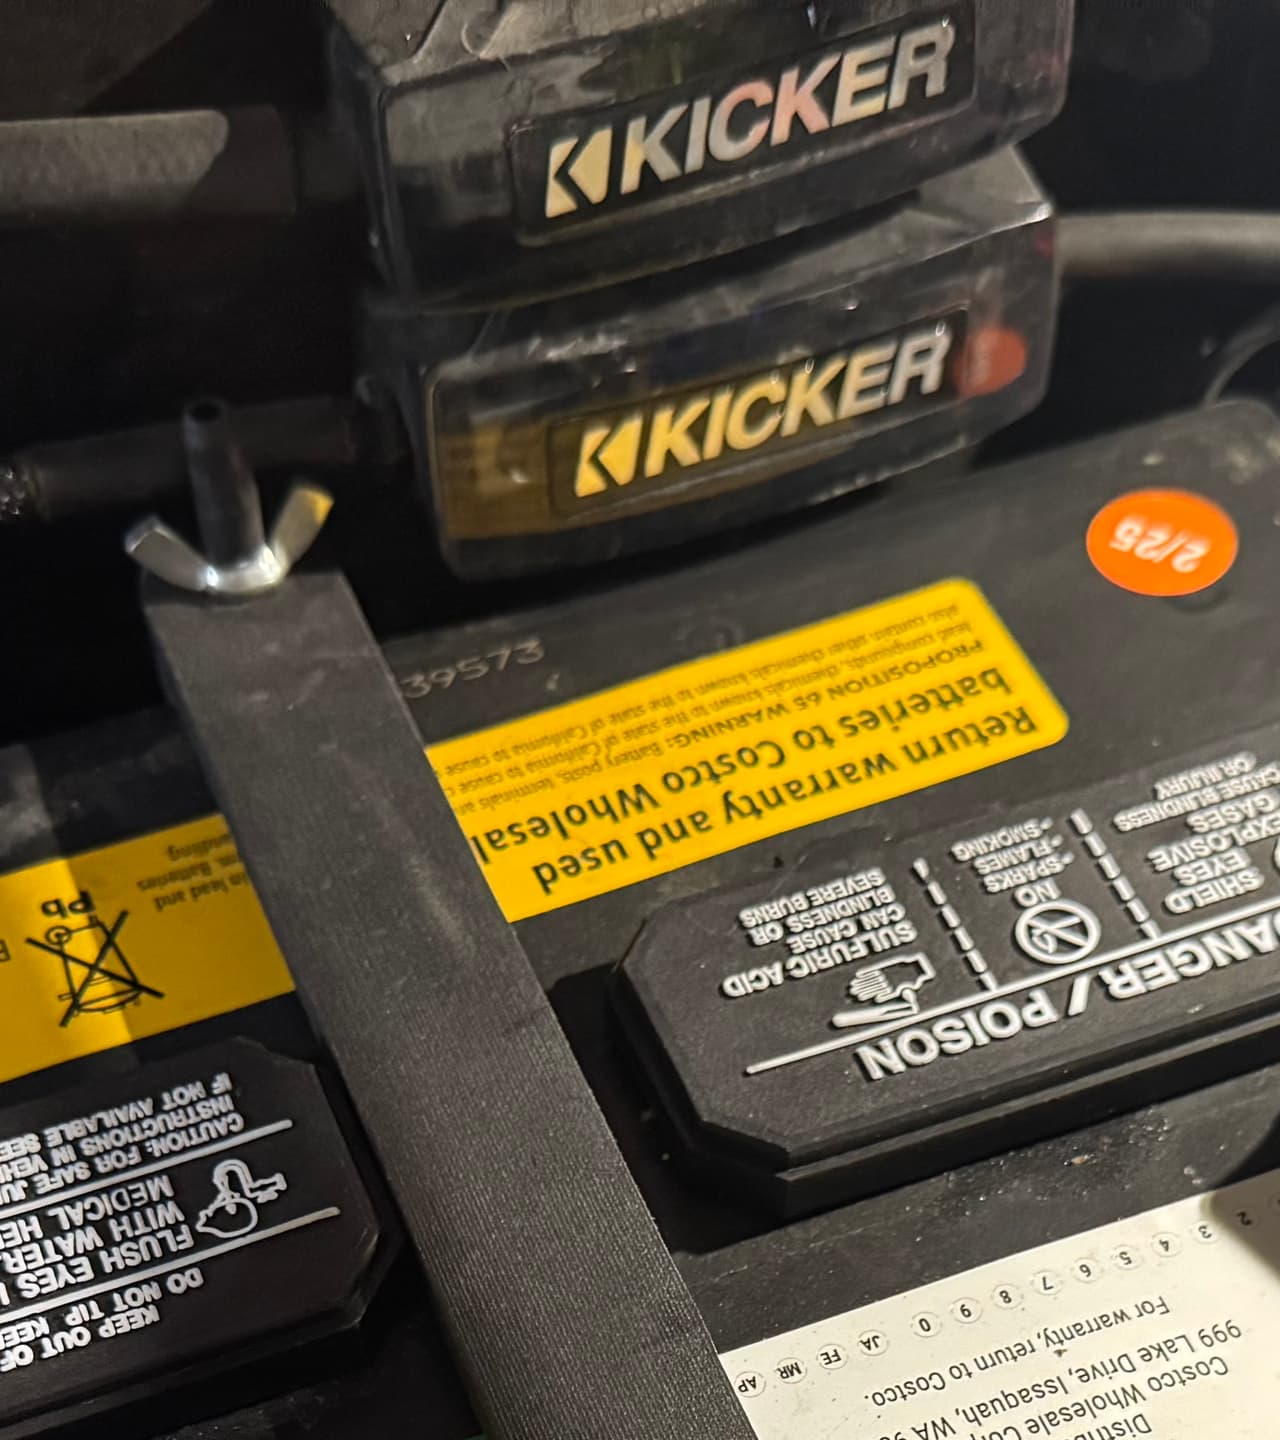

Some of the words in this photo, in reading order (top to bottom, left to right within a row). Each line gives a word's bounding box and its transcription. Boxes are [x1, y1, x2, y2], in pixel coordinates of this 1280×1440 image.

[621, 22, 956, 195] KICKER
[644, 333, 953, 478] KICKER
[1109, 516, 1210, 573] 2/25
[825, 639, 984, 701] PROPOSITION
[791, 690, 822, 712] 65
[836, 664, 1013, 747] batteries
[665, 700, 788, 751] WARNING:
[790, 721, 835, 758] to
[900, 703, 1038, 771] Return
[659, 735, 788, 801] Costco
[1151, 762, 1222, 800] INJURY
[1217, 749, 1258, 778] OR
[717, 741, 900, 828] warranty
[468, 779, 661, 867] Wholesal
[1110, 781, 1221, 833] BLINDNESS
[634, 808, 716, 863] and
[950, 817, 1044, 862] SMOKING
[972, 835, 1052, 874] FLAMES
[529, 836, 632, 898] used
[803, 864, 886, 906] SEVERE
[982, 853, 1063, 893] SPARKS
[1171, 845, 1250, 888] EYES
[39, 888, 95, 924] Pb
[783, 883, 894, 933] BLINDNESS
[1011, 876, 1061, 909] NO
[1160, 864, 1266, 916] SHIELD
[736, 891, 807, 928] BURNS
[857, 902, 907, 931] CAN
[747, 919, 785, 946] OR
[783, 918, 918, 978] SULFURIC
[785, 917, 859, 954] CAUSE
[719, 960, 787, 1000] ACID
[1058, 972, 1098, 1016] /
[853, 985, 1061, 1083] POISON
[157, 1079, 207, 1111] NOT
[207, 1070, 232, 1095] IF
[40, 1095, 155, 1147] AVAILABLE
[77, 1092, 235, 1157] INSTRUCTIONS
[142, 1109, 246, 1159] CAUTION:
[48, 1142, 77, 1166] IN
[91, 1143, 142, 1175] FOR
[29, 1158, 92, 1195] SAFE
[45, 1172, 175, 1233] MEDICAL
[106, 1197, 185, 1242] WITH
[1235, 1209, 1252, 1227] 2
[96, 1222, 195, 1274] FLUSH
[1158, 1237, 1171, 1252] 4
[1197, 1223, 1212, 1240] 3
[1078, 1262, 1092, 1278] 6
[1117, 1249, 1131, 1265] 5
[13, 1253, 94, 1300] EYES
[108, 1278, 163, 1313] NOT
[163, 1265, 204, 1295] DO
[1039, 1274, 1053, 1290] 7
[61, 1297, 104, 1327] TIP
[958, 1302, 972, 1319] 9
[998, 1288, 1011, 1304] 8
[1133, 1294, 1170, 1322] For
[35, 1323, 93, 1358] OUT
[94, 1303, 160, 1340] KEEP
[917, 1316, 931, 1333] 0
[1035, 1303, 1132, 1353] warranty,
[1195, 1316, 1242, 1348] 999
[819, 1348, 841, 1365] FE
[858, 1334, 882, 1352] JA
[972, 1337, 1037, 1375] return
[1135, 1332, 1194, 1369] Lake
[735, 1375, 758, 1393] AP
[776, 1360, 802, 1380] MR
[947, 1361, 973, 1383] to
[1067, 1349, 1136, 1391] Drive,
[1144, 1353, 1229, 1397] Costco
[862, 1369, 947, 1412] Costco.
[952, 1372, 1070, 1432] Issaquah,
[1024, 1381, 1145, 1440] Wholesale
